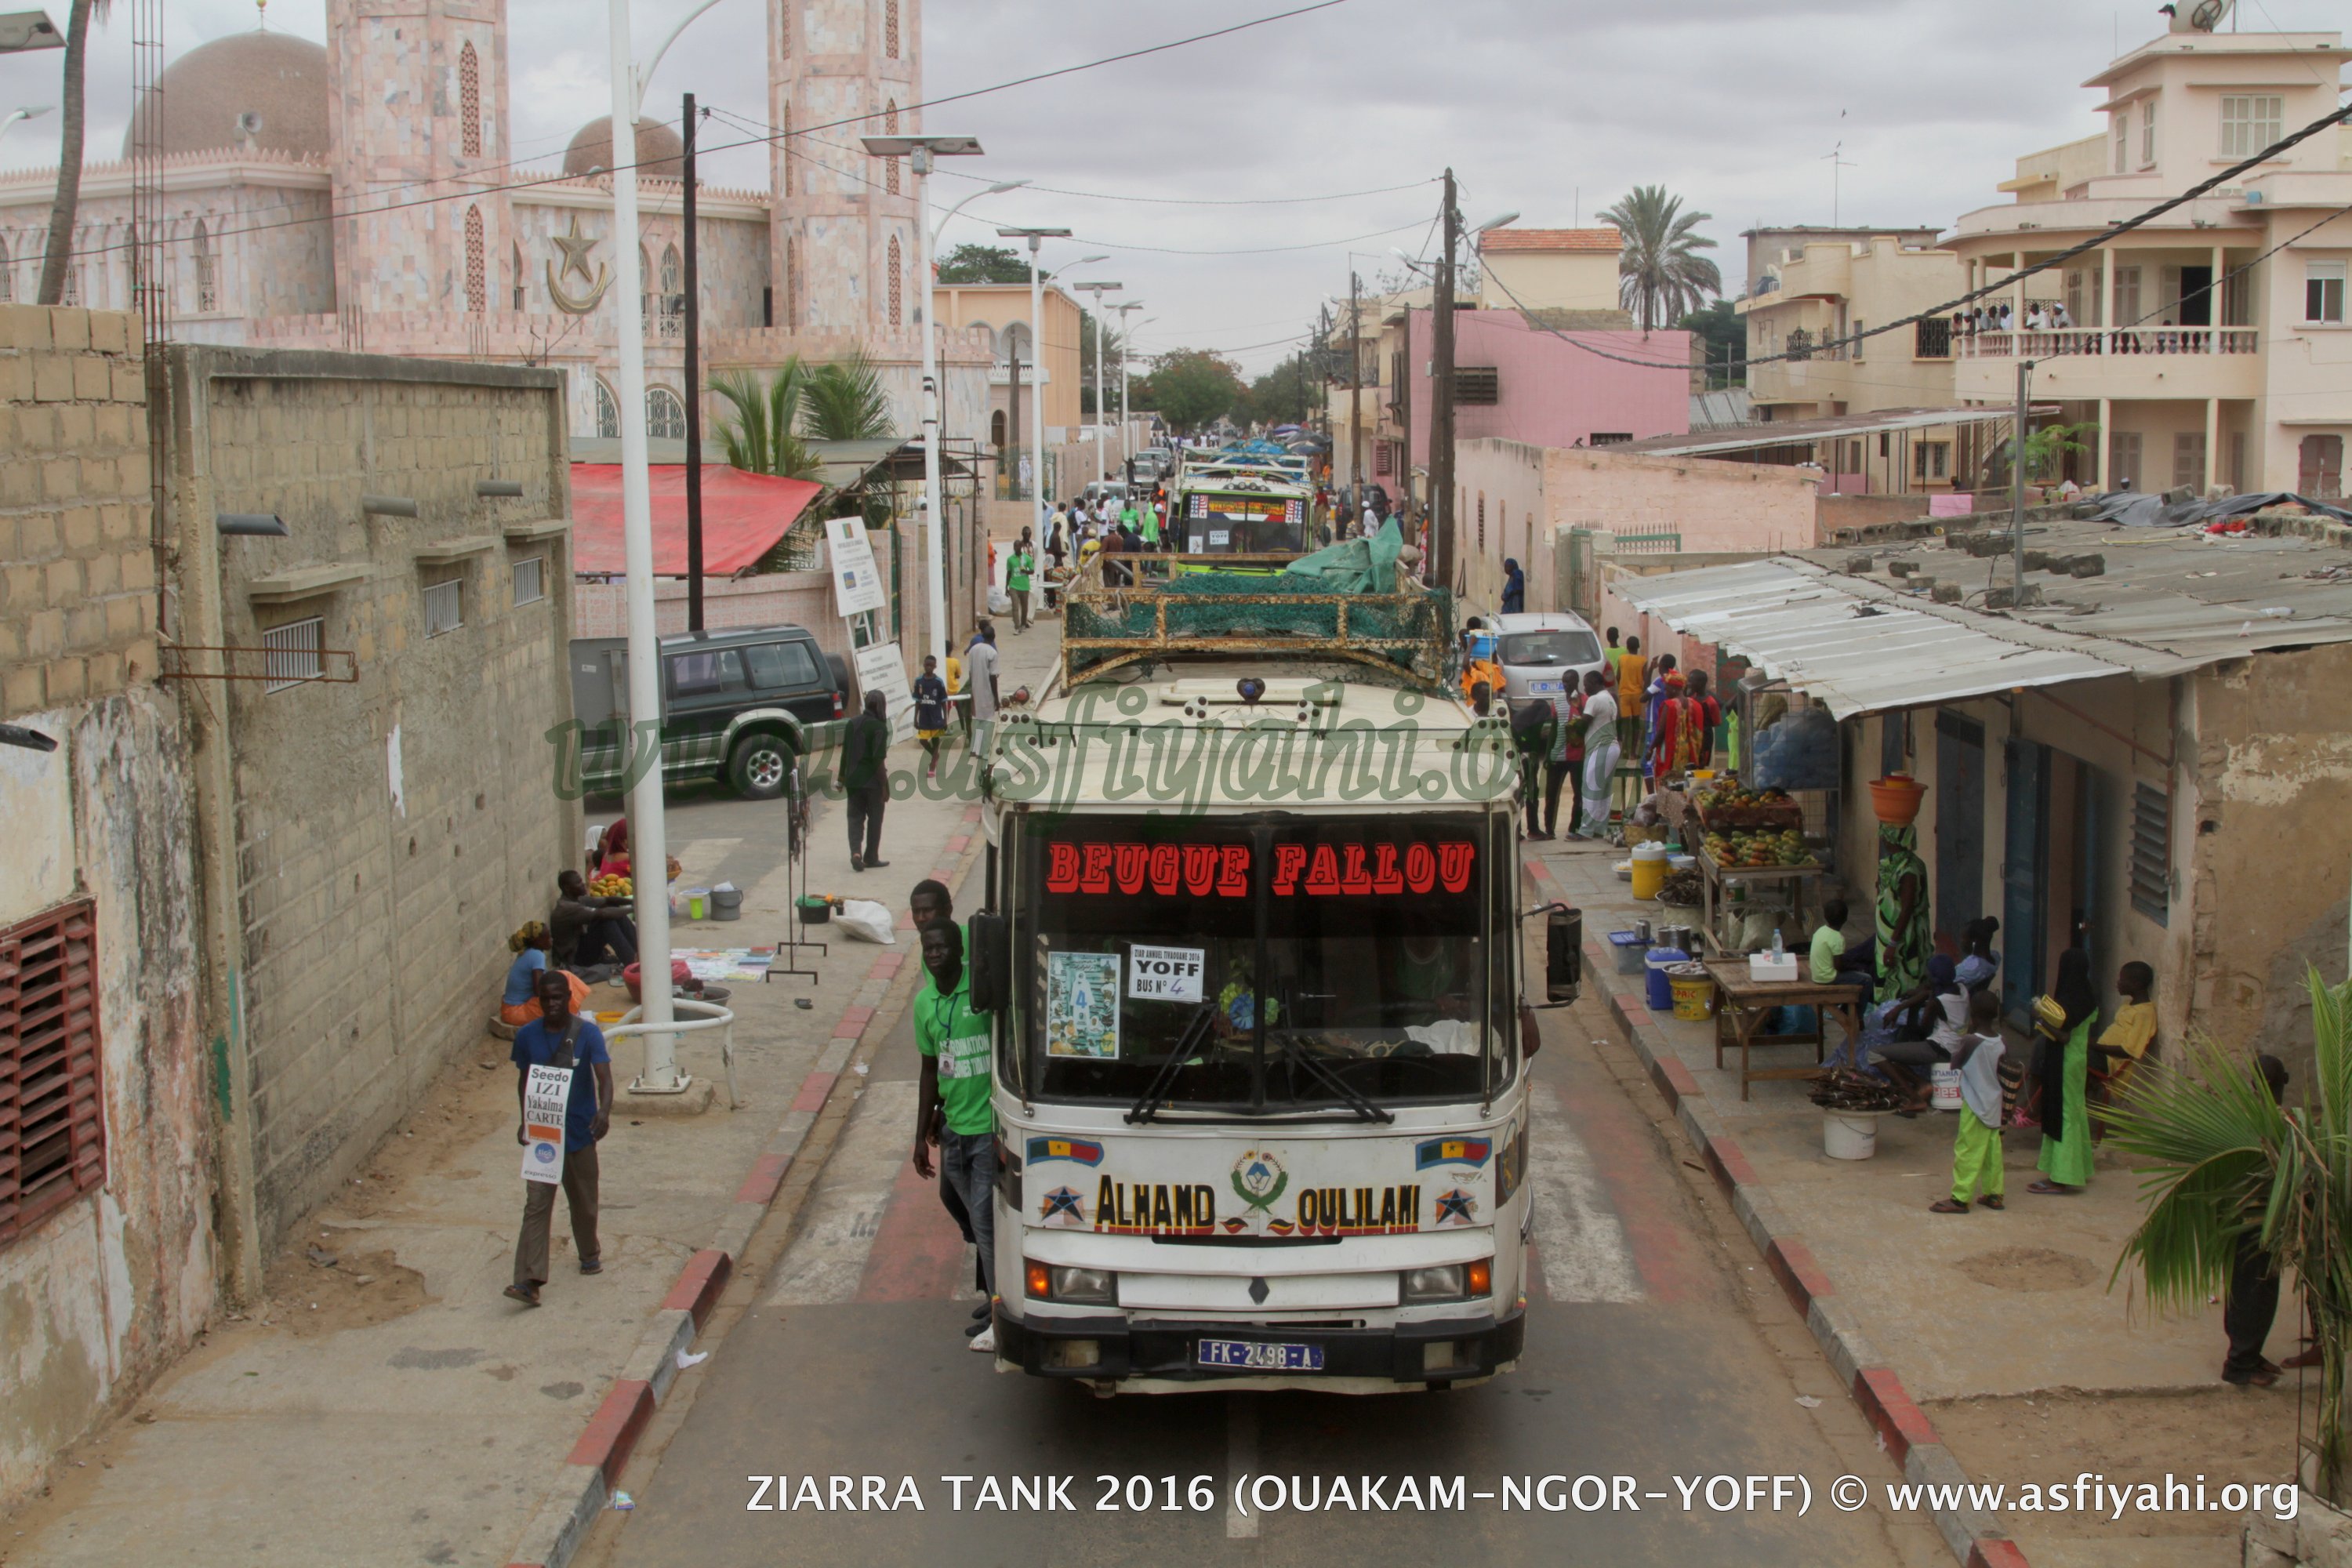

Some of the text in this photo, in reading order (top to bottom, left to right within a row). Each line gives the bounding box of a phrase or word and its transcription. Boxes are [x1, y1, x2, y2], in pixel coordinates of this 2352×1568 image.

[1046, 840, 1475, 898] BEUGUE FALLOU
[1134, 949, 1200, 961] ZIAR ANNUEL TIVAOUANE 2016
[1135, 960, 1200, 977] YOFF
[1137, 978, 1185, 994] BUS N° 4
[1076, 990, 1087, 1009] 4
[531, 1068, 569, 1083] Seedo
[535, 1081, 561, 1097] IZI
[527, 1094, 563, 1112] Yakalma
[526, 1110, 563, 1126] CARTE
[1210, 1342, 1311, 1367] FK-2498-A
